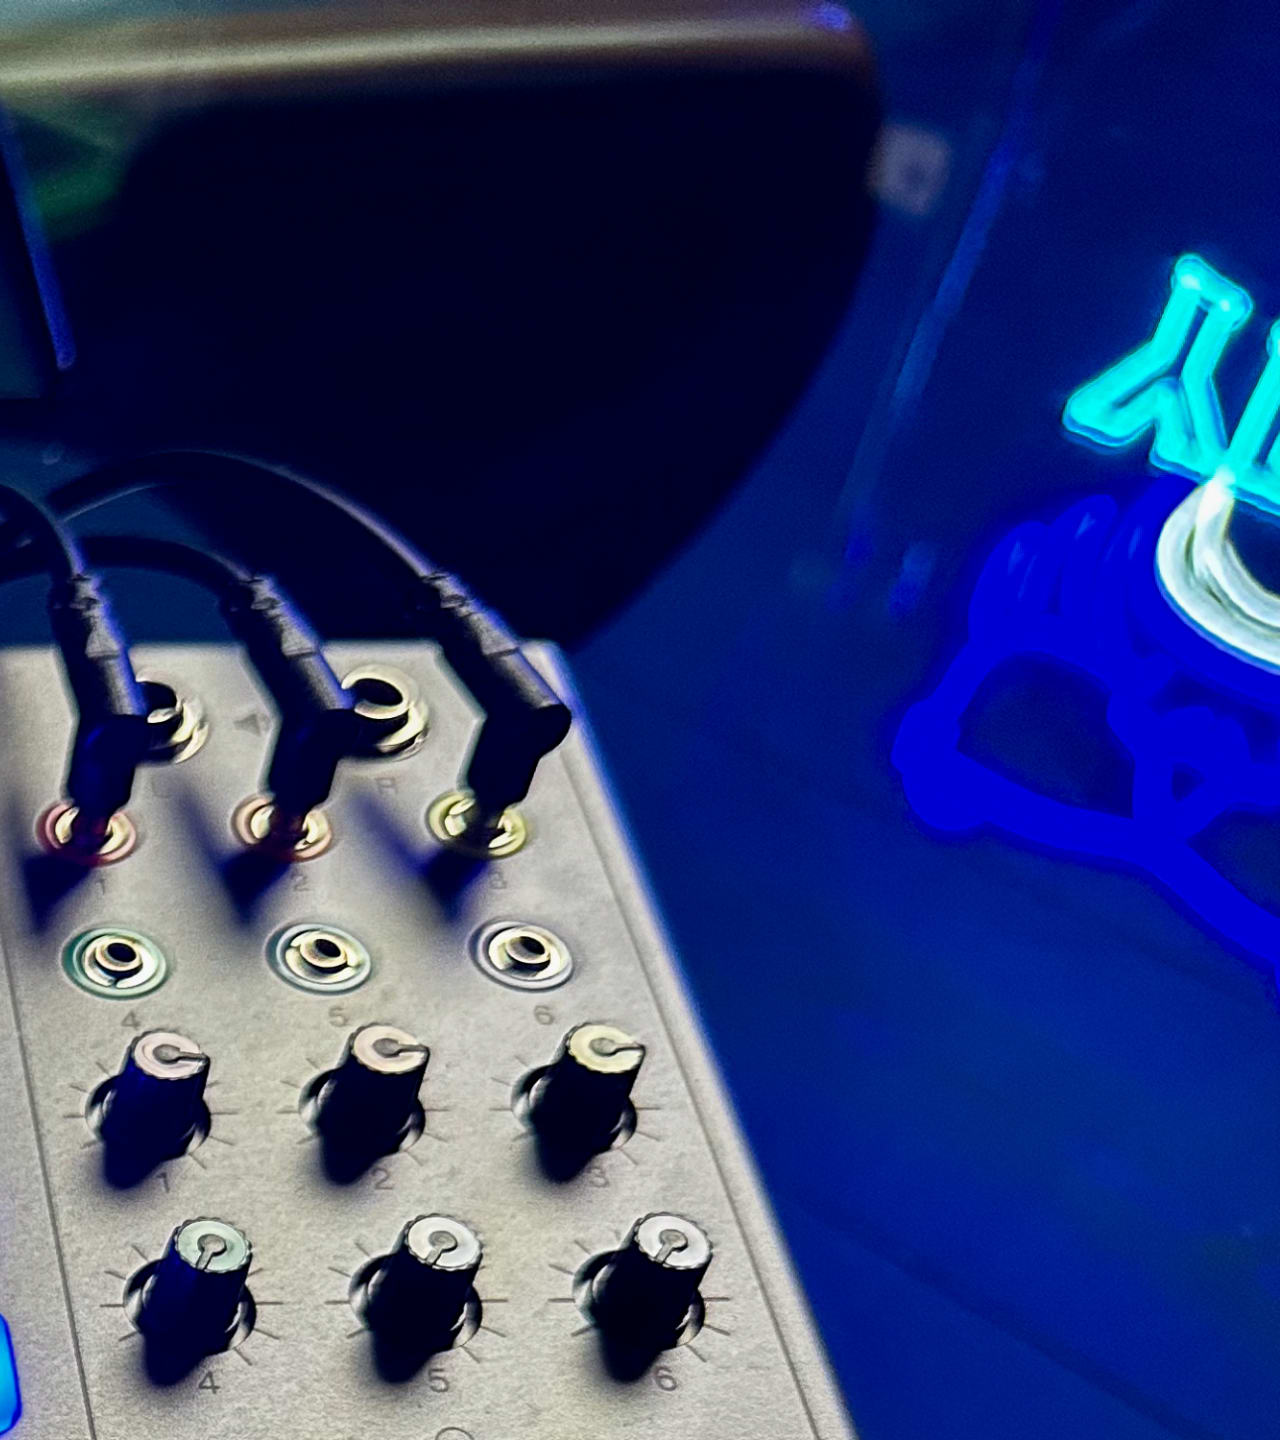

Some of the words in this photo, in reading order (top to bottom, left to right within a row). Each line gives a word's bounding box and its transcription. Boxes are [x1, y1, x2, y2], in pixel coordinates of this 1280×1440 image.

[292, 874, 309, 892] 2
[120, 1010, 142, 1031] 4
[328, 1006, 348, 1027] 5
[533, 1005, 555, 1026] 6
[155, 1172, 171, 1193] 1
[373, 1168, 394, 1191] 2
[588, 1168, 610, 1189] 3
[197, 1370, 221, 1395] 4
[427, 1368, 451, 1394] 5
[654, 1366, 679, 1392] 6
